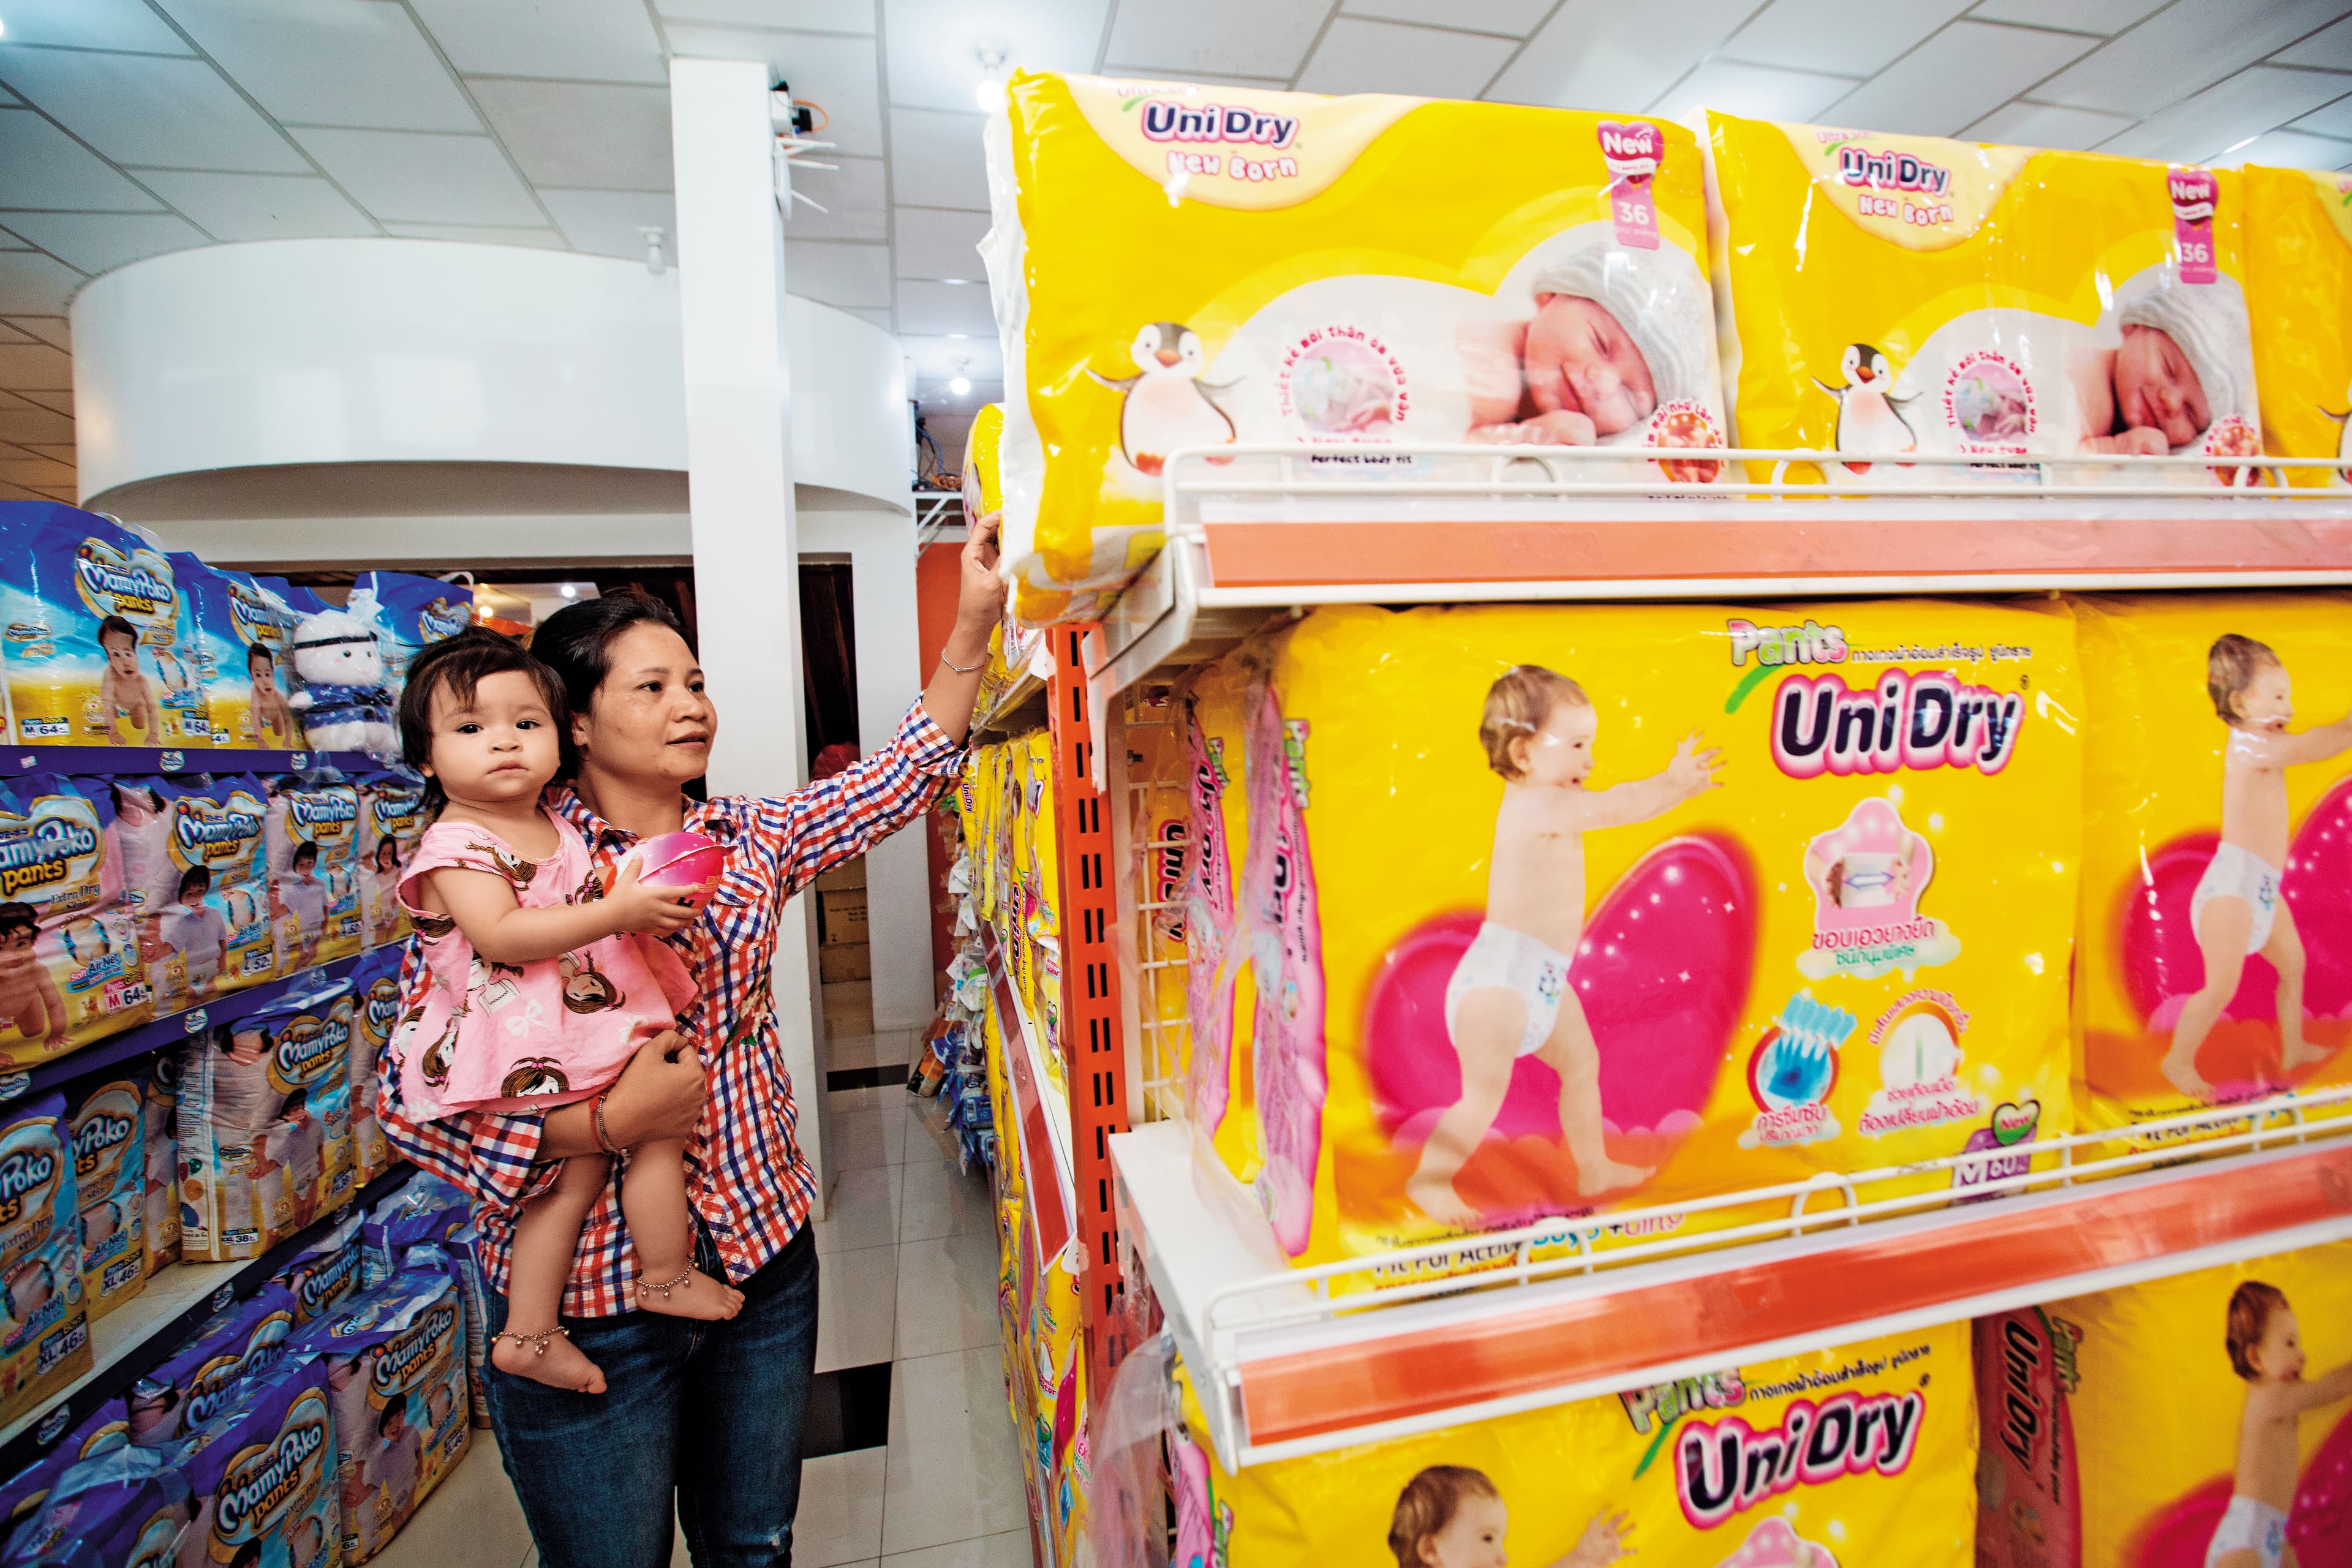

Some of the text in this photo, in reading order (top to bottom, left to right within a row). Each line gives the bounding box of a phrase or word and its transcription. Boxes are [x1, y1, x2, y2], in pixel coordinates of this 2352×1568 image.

[1602, 130, 1653, 154] New
[1229, 156, 1298, 183] Born
[2170, 180, 2211, 200] New
[1617, 201, 1649, 225] 36
[1859, 194, 1954, 226] New Born
[2182, 243, 2209, 263] 36
[1727, 619, 1849, 666] Pants
[40, 725, 58, 735] 64
[1776, 676, 2019, 767] UniDry
[290, 794, 356, 827] MamyPoko
[0, 819, 96, 869] amyPoko
[203, 840, 239, 863] pants
[2, 860, 65, 896] pants
[79, 883, 100, 898] Dry
[70, 953, 120, 982] Soft Air Net
[254, 956, 267, 970] 52
[108, 987, 141, 1008] M 64
[277, 1020, 349, 1071] MamyPoko
[73, 1115, 130, 1161] yPoko
[0, 1155, 53, 1199] Poko
[235, 1235, 249, 1243] 38
[104, 1265, 135, 1289] XL 46
[38, 1331, 80, 1365] XL 46
[375, 1308, 453, 1385] MamyPoko
[401, 1343, 437, 1386] pants
[1618, 1367, 1746, 1434] Pants
[1999, 1320, 2041, 1473] UniDry
[1680, 1393, 1921, 1520] UniDry
[217, 1425, 323, 1531] MamyPoko
[253, 1469, 300, 1529] pants
